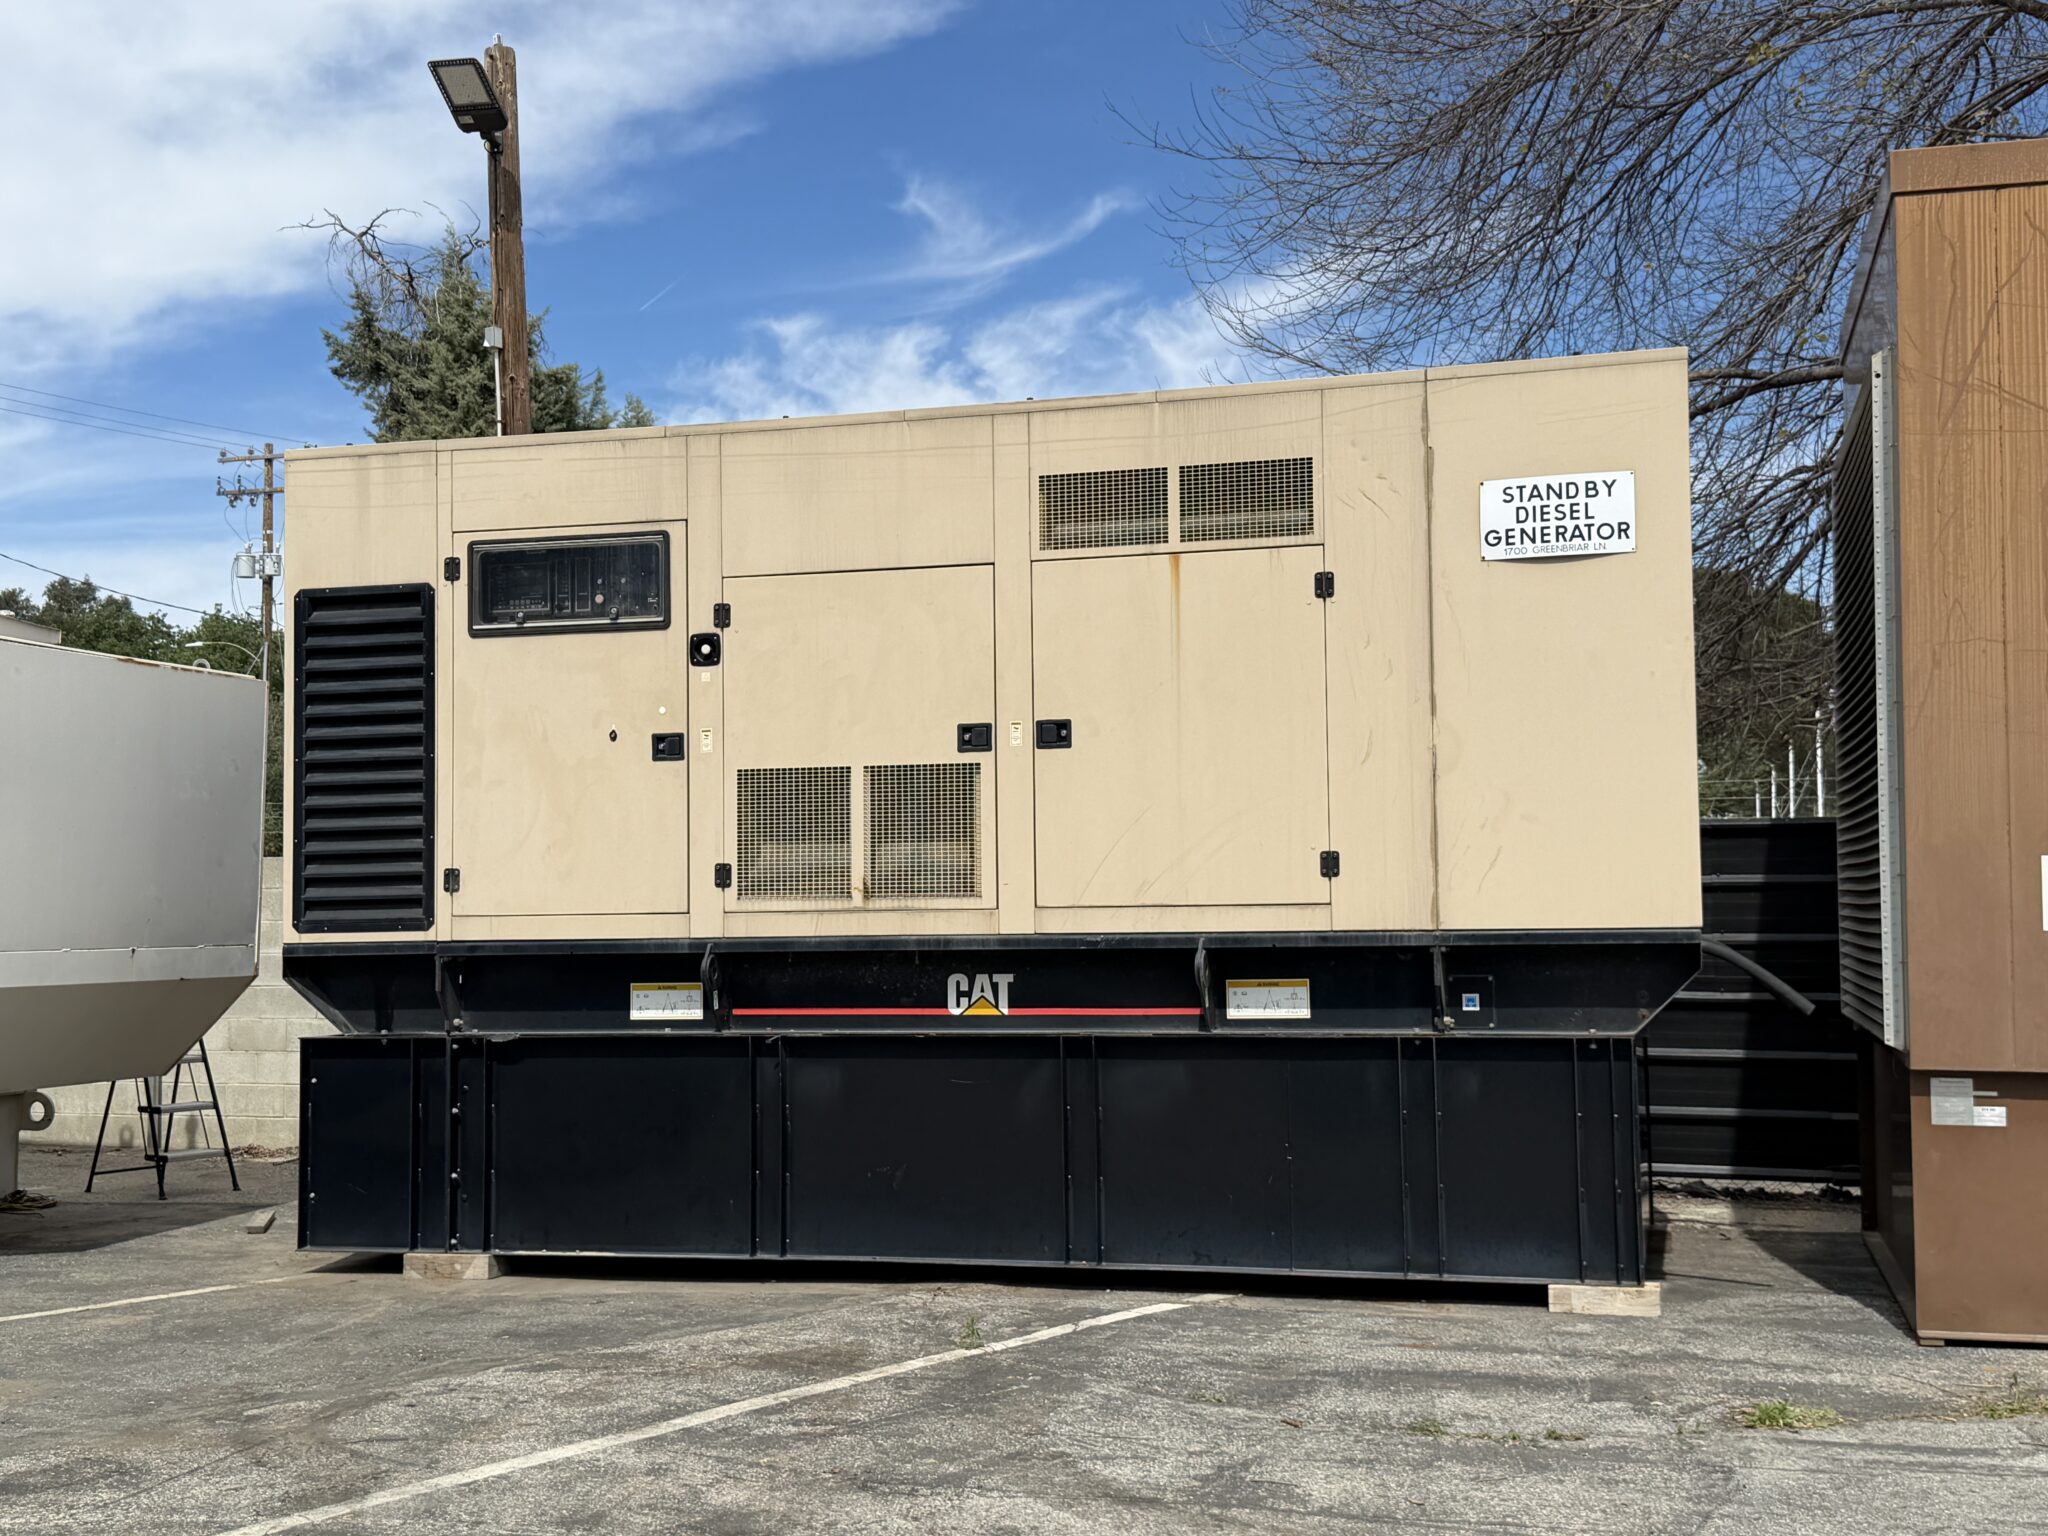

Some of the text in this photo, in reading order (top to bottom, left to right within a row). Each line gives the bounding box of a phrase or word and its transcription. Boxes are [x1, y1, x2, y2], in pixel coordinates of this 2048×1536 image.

[1502, 479, 1617, 503] STANDBY
[1515, 502, 1595, 524] DIESEL
[1484, 521, 1631, 547] GENERATOR
[1504, 547, 1528, 556] 1700
[1532, 542, 1589, 554] GREENBRIAR
[947, 973, 1014, 1016] CAT
